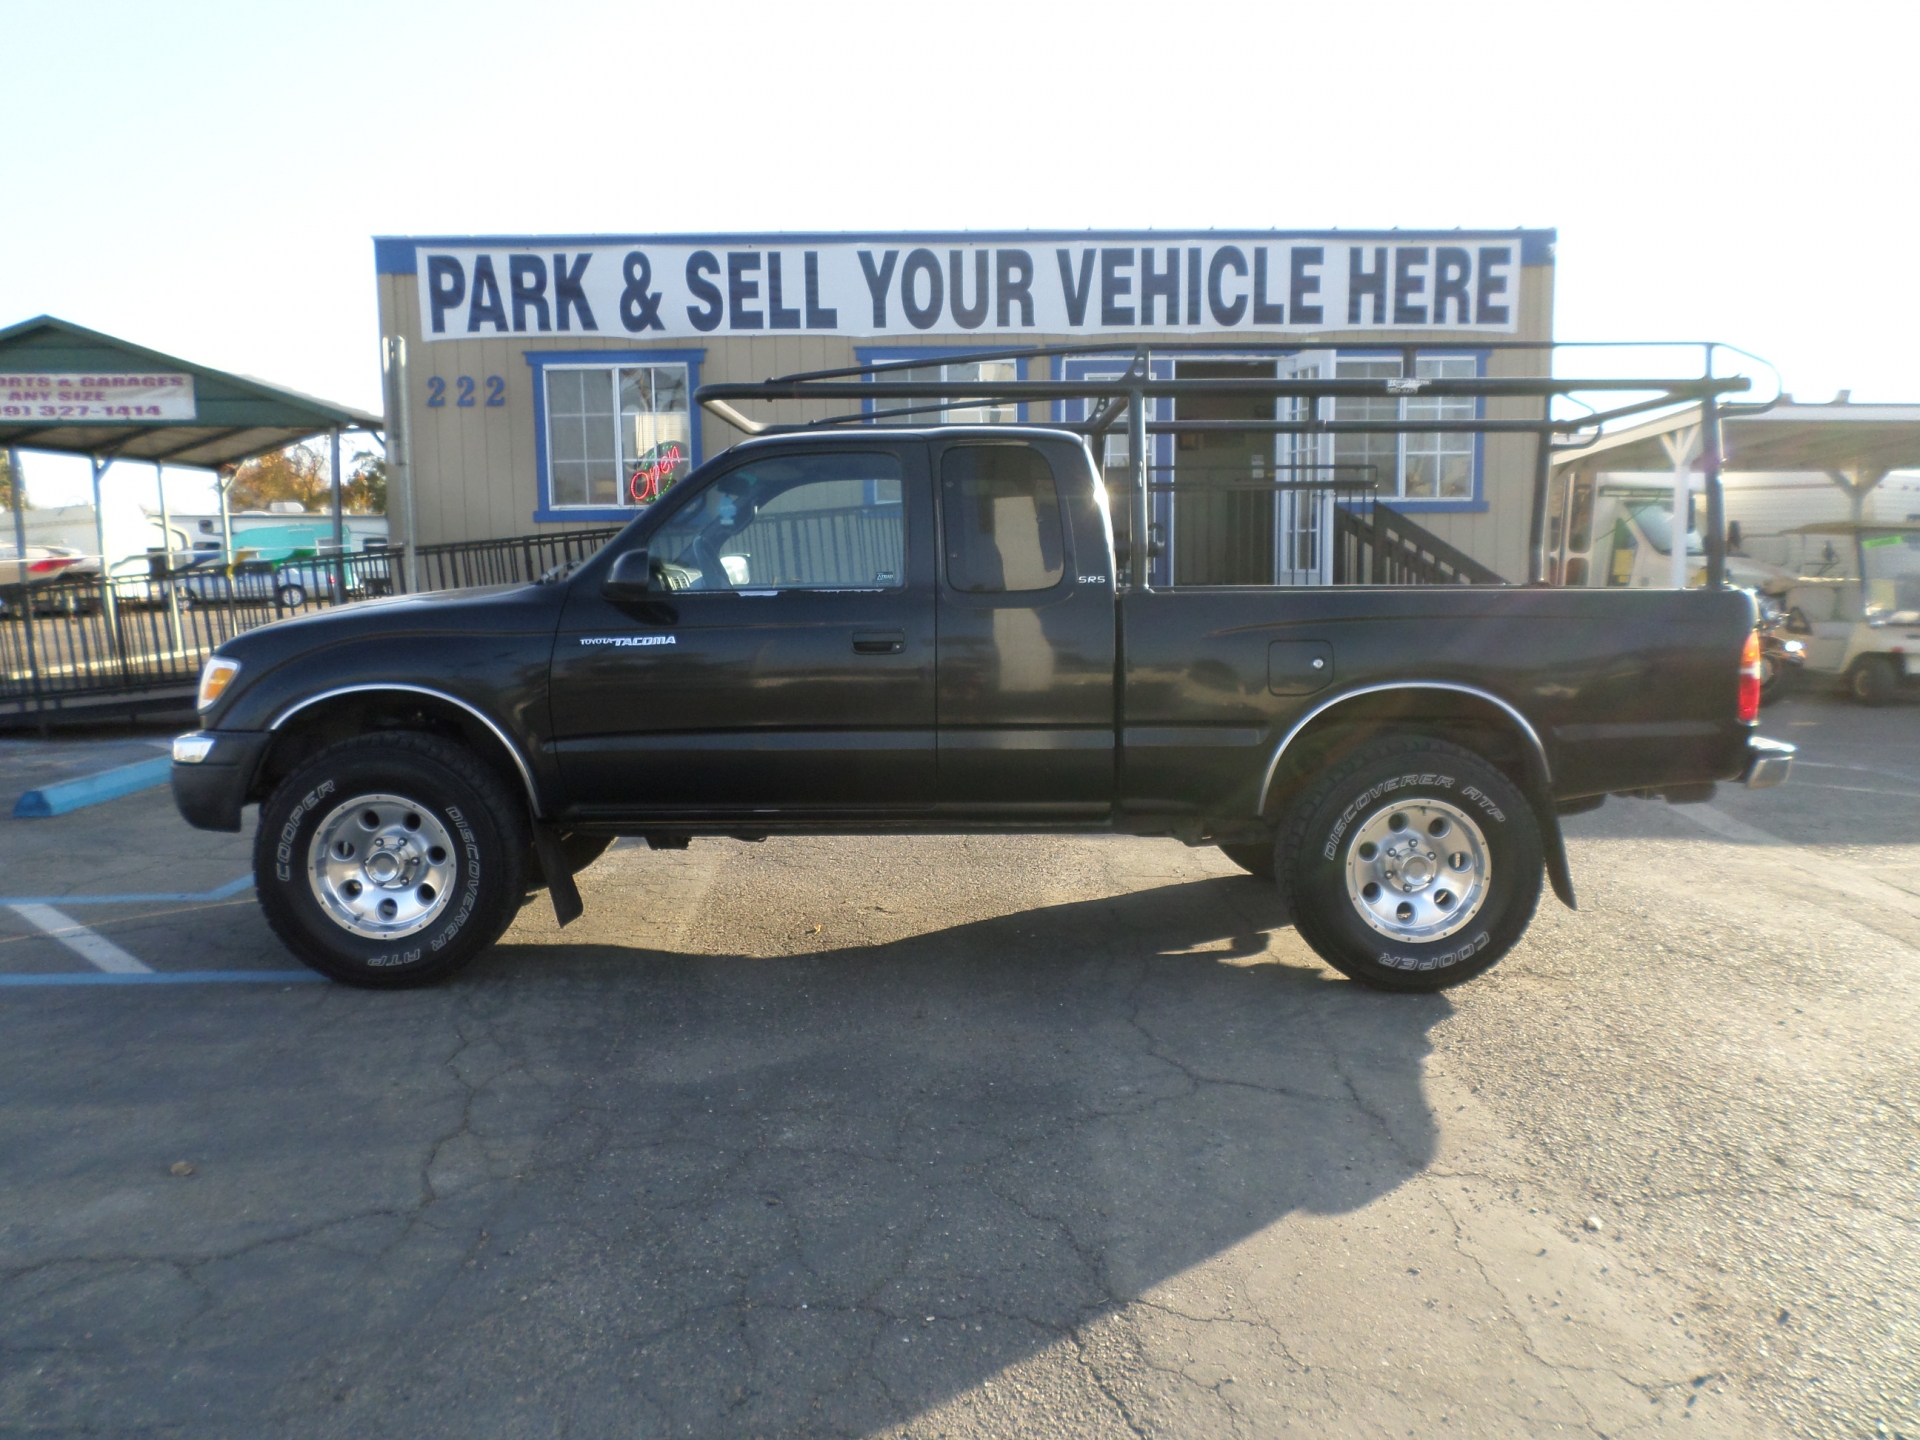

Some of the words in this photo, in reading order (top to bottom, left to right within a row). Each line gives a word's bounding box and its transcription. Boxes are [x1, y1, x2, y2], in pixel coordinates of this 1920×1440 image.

[427, 253, 599, 334] PARK
[619, 250, 665, 333] &
[685, 249, 838, 332] SELL
[857, 248, 1035, 329] YOUR
[1056, 245, 1324, 328] VEHICLE
[1347, 246, 1512, 325] HERE
[8, 391, 51, 402] ANY
[58, 391, 106, 401] SIZE
[80, 376, 183, 387] GARAGES
[427, 375, 506, 407] 222
[0, 405, 31, 416] 9)
[38, 405, 162, 416] 327-1414
[630, 445, 681, 500] Open
[580, 637, 615, 646] TOYOTA
[613, 635, 676, 647] TACOMA
[276, 779, 335, 882] COOPER
[1324, 774, 1455, 860] DISCOVERER
[430, 805, 480, 952] DISCOVERER
[1378, 931, 1490, 972] COOPER
